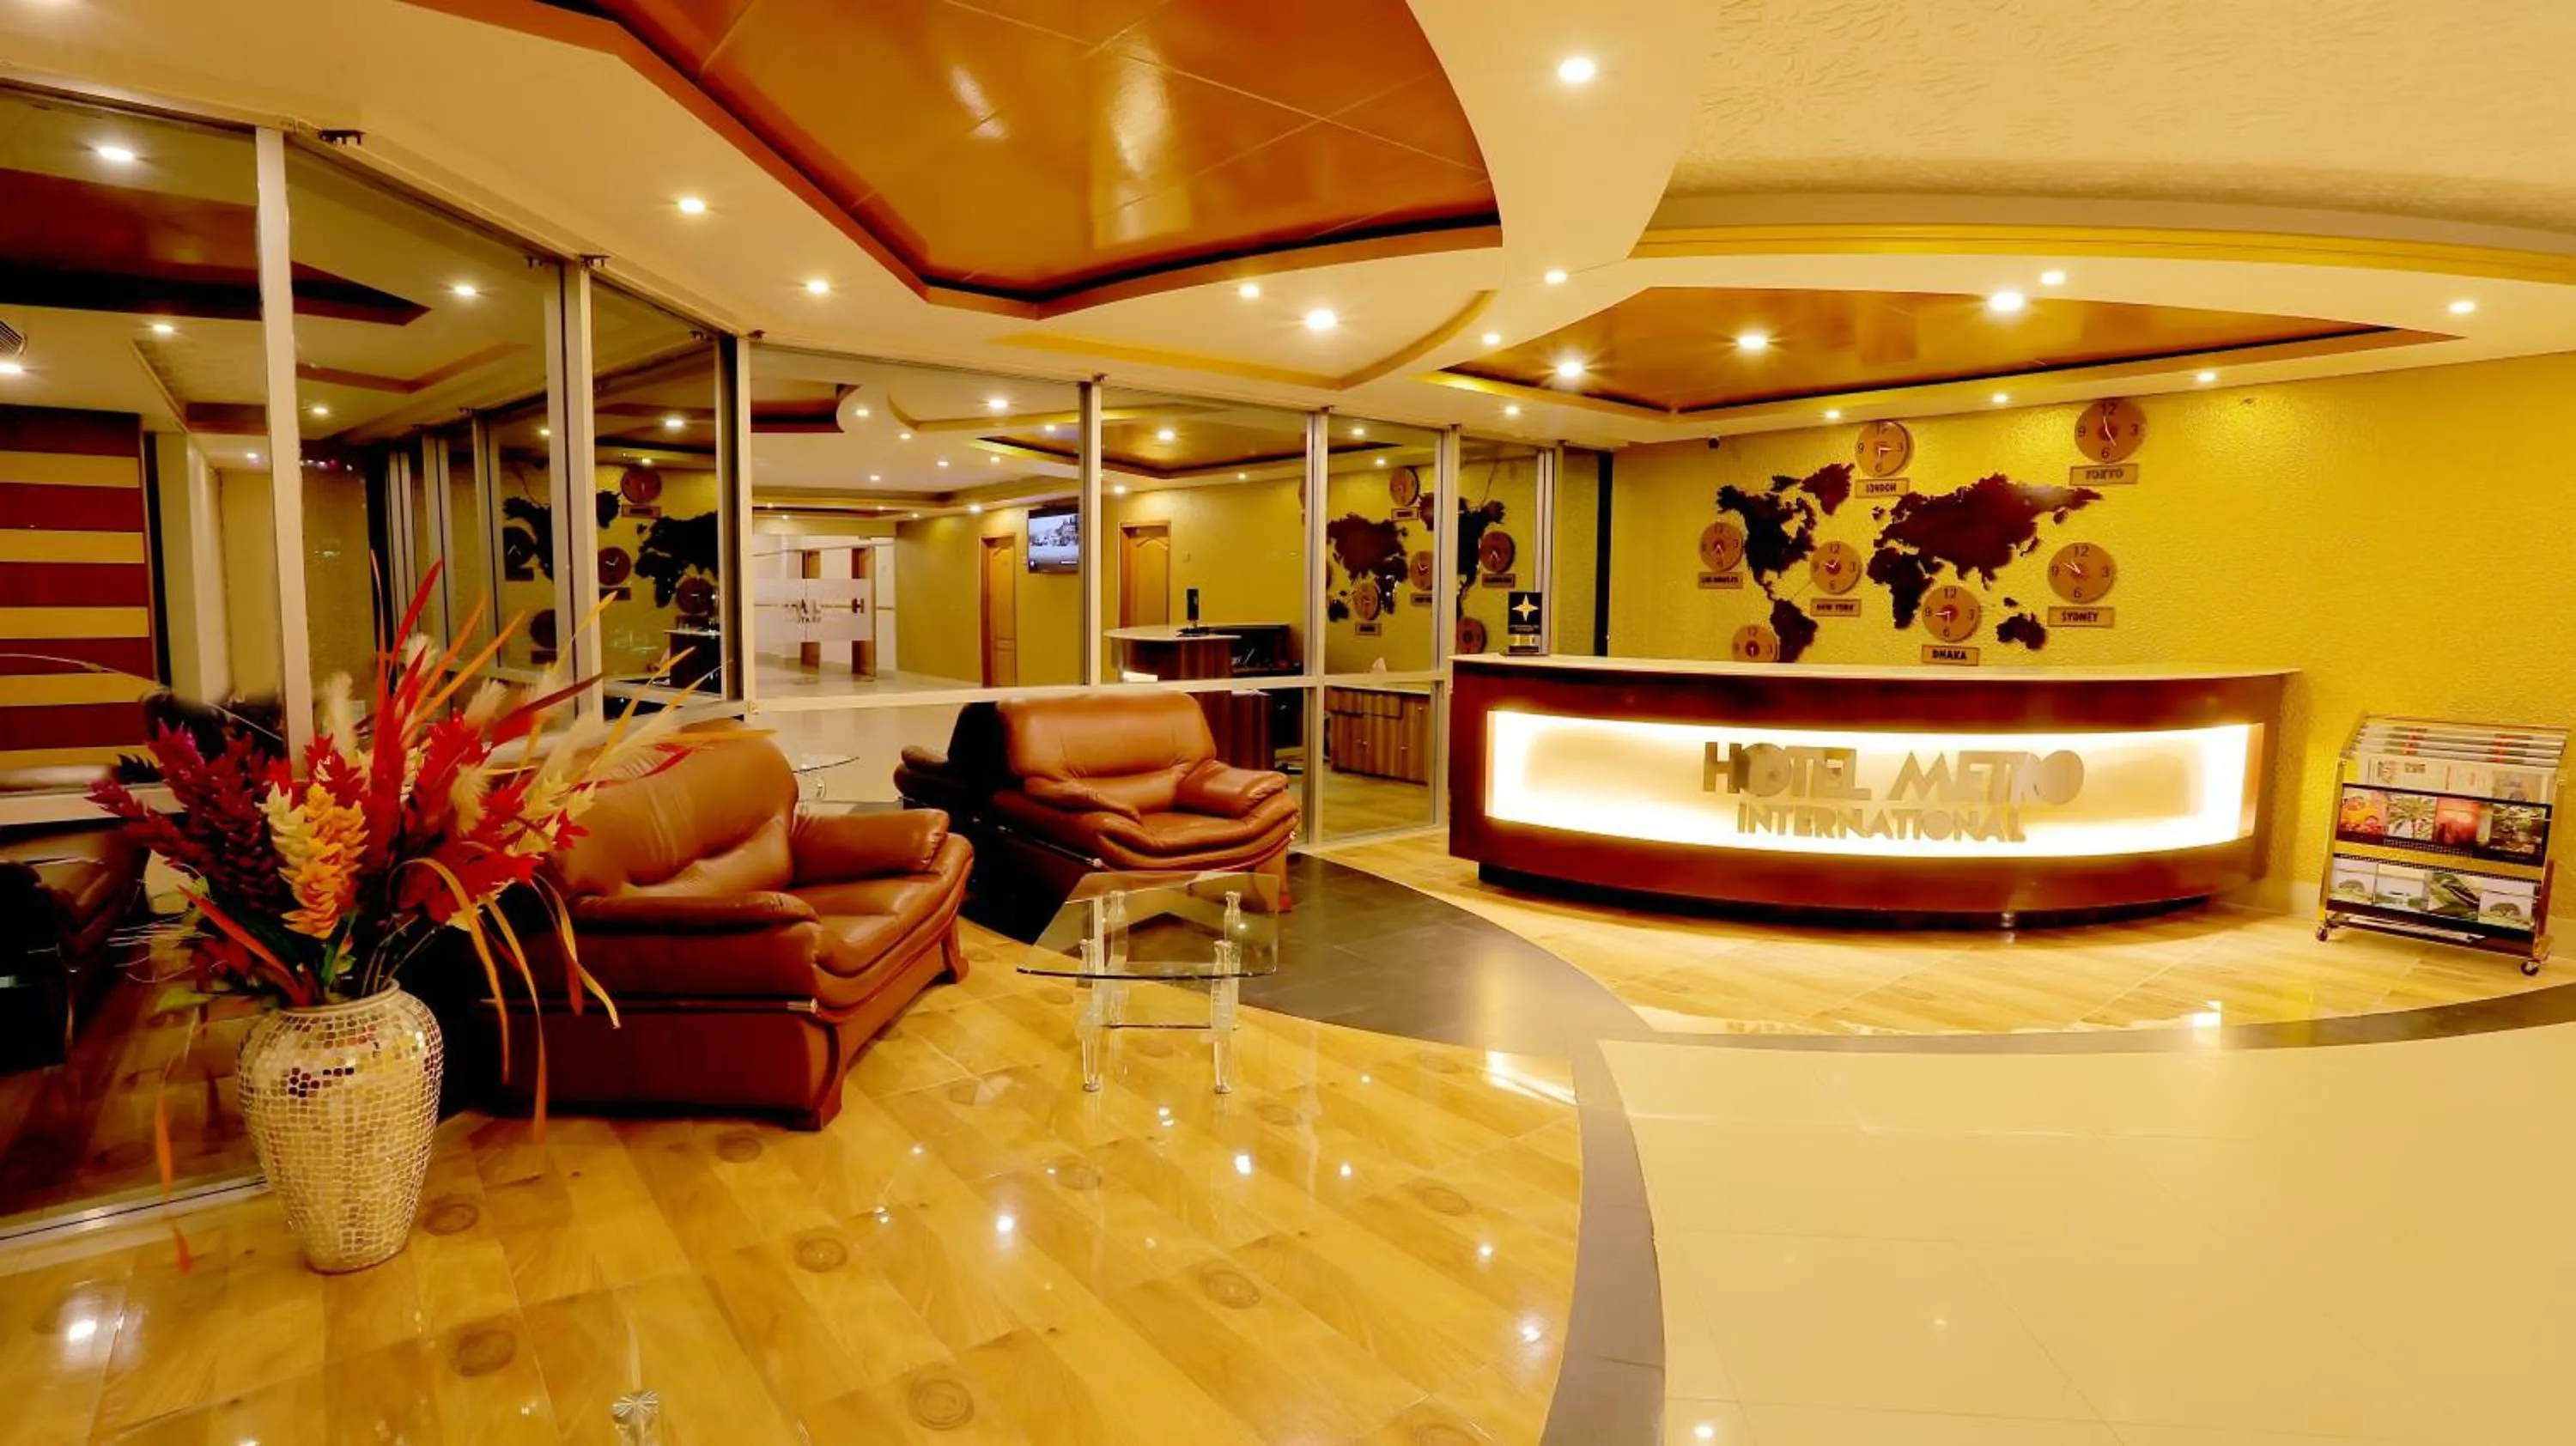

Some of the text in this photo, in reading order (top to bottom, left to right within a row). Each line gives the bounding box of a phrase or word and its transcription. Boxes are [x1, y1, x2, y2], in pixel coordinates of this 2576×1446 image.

[2085, 468, 2124, 480] TOKYO
[1866, 483, 1896, 494] LONDON
[2074, 545, 2089, 557] 12
[2061, 611, 2099, 622] SYDNEY
[1932, 649, 1967, 660] DHAKA
[1703, 741, 2085, 805] HOTEL METRO
[1737, 802, 2026, 842] INTERNATIONAL
